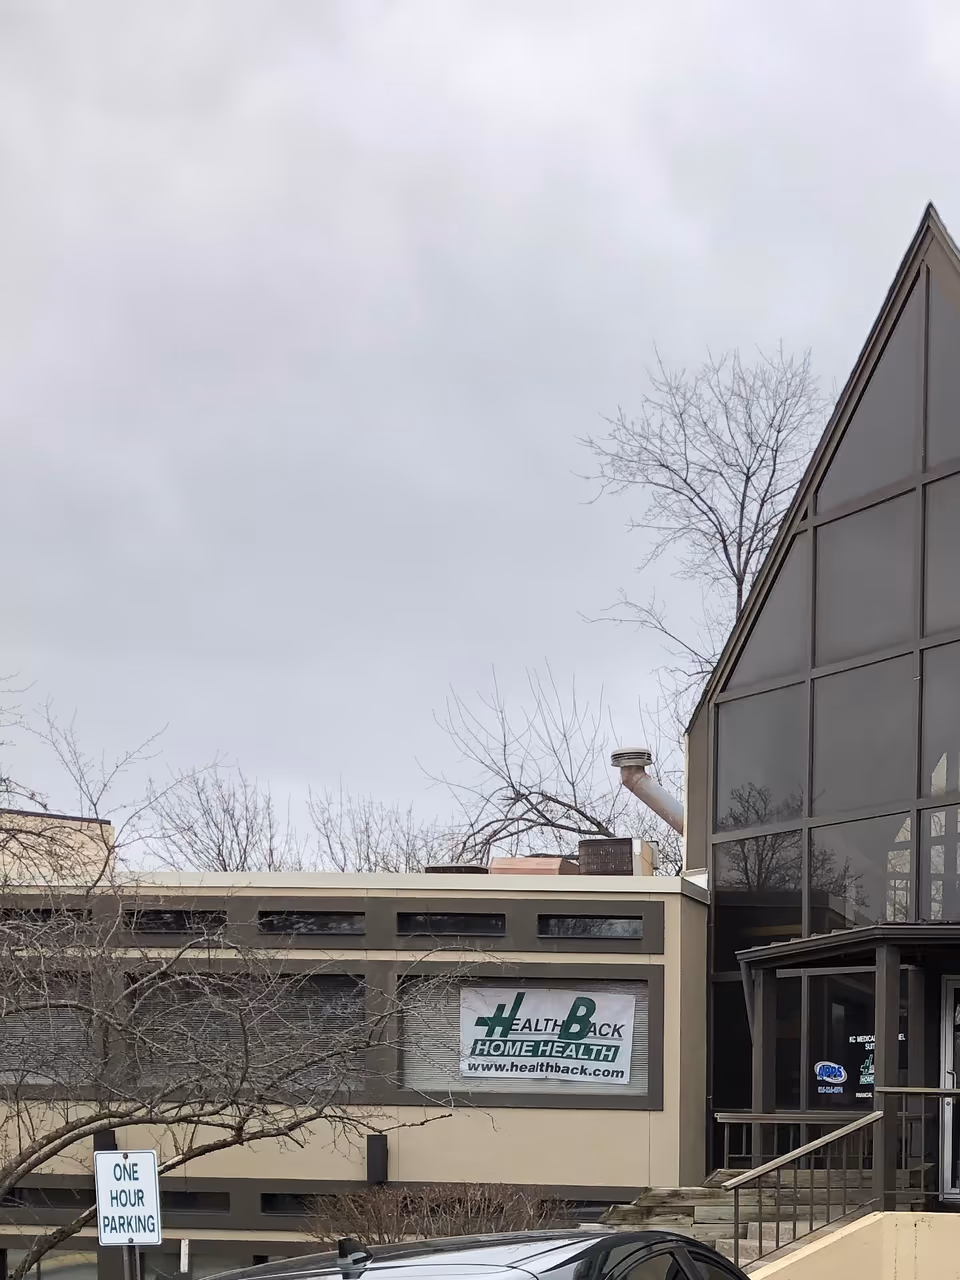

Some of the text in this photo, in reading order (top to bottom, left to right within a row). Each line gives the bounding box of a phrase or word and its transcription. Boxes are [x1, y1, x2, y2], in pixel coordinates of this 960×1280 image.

[475, 1041, 615, 1061] HOME HEALTH
[467, 1061, 625, 1079] www.healthback.com
[113, 1163, 139, 1181] ONE
[110, 1189, 145, 1207] HOUR
[103, 1215, 155, 1233] PARKING
